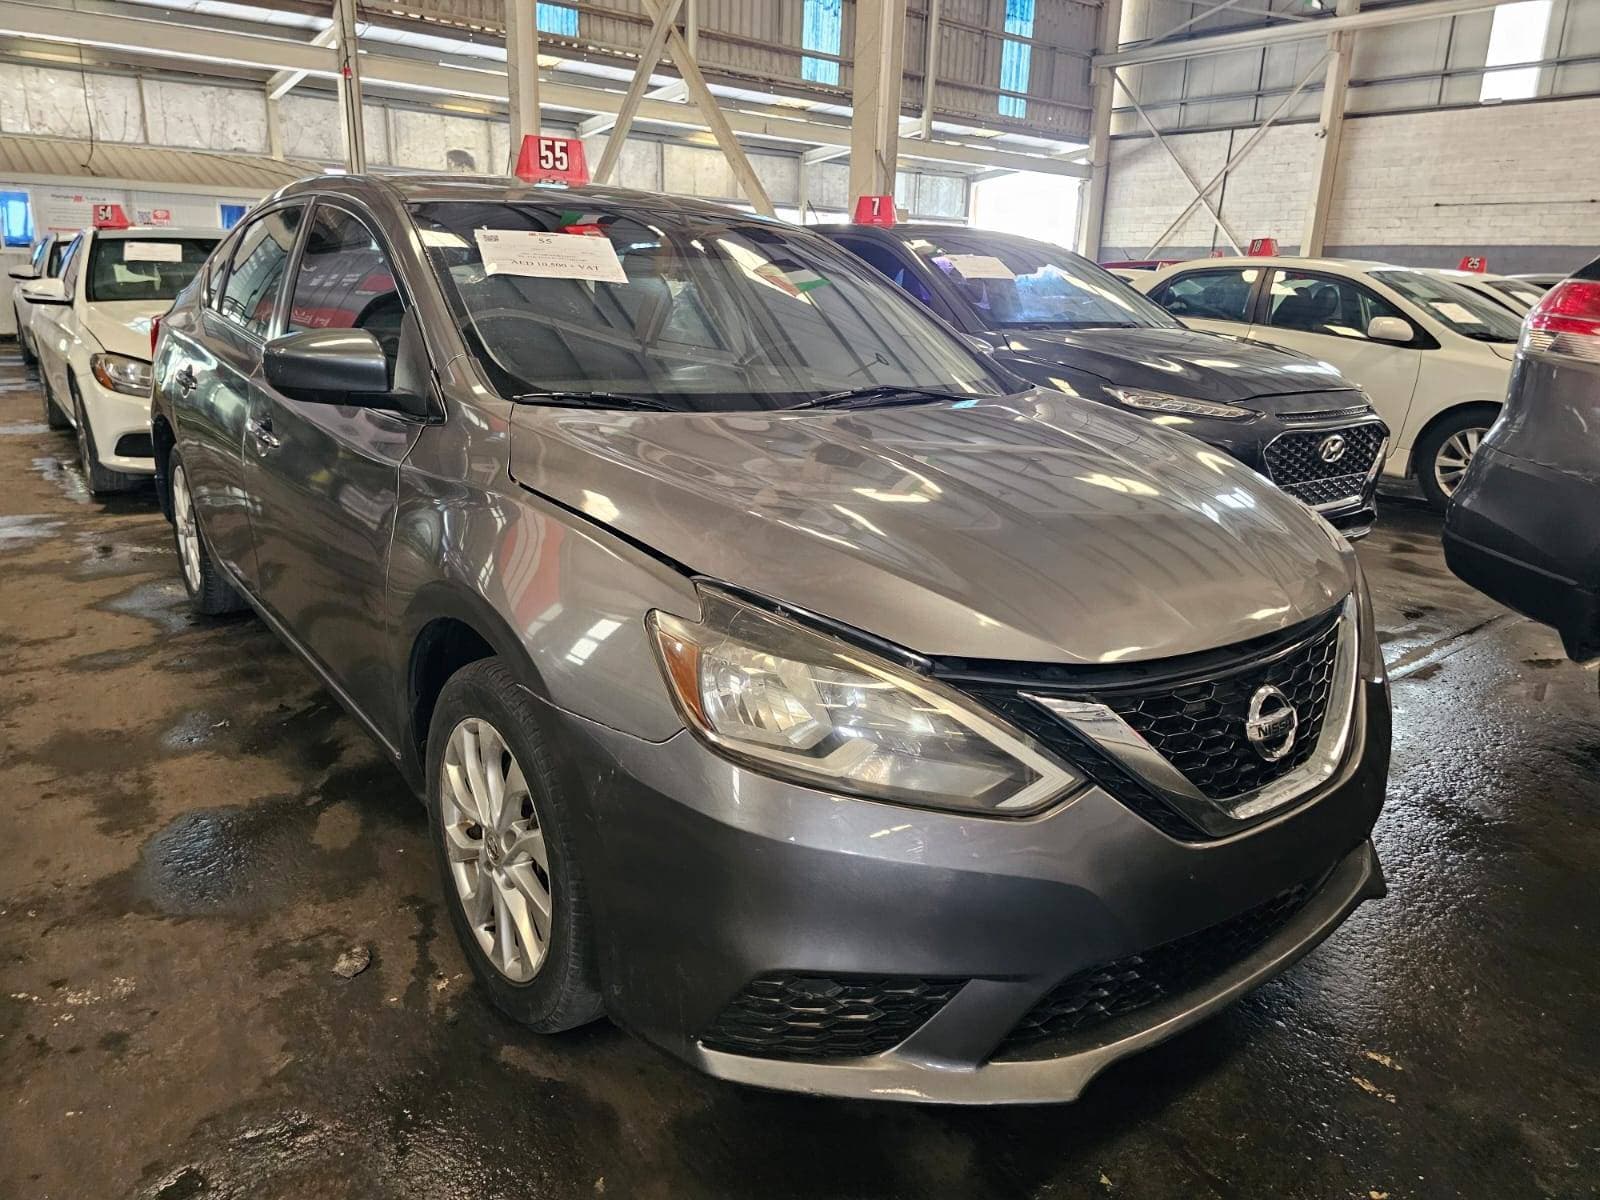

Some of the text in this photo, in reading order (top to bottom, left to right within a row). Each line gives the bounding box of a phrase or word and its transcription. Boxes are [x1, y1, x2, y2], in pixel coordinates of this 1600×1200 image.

[540, 139, 568, 171] 55
[98, 205, 112, 221] 54
[871, 197, 880, 216] 7
[1467, 257, 1480, 269] 25
